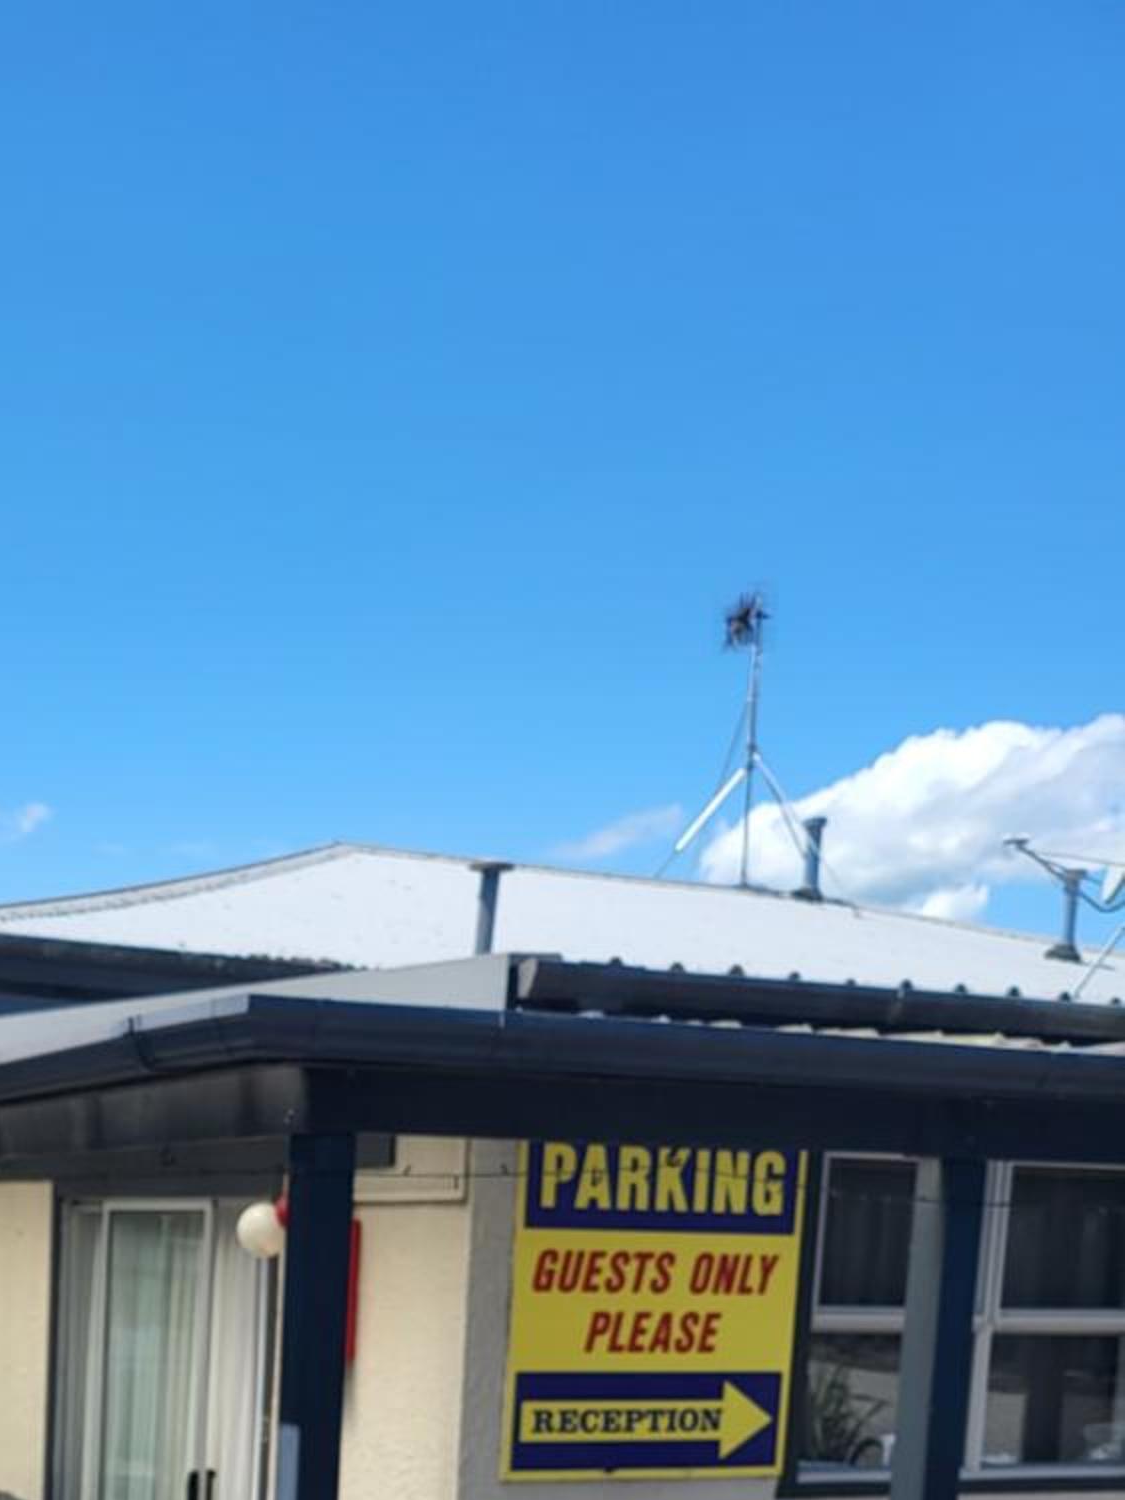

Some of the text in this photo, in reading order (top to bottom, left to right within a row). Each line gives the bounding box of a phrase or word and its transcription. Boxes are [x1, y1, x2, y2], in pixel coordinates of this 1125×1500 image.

[540, 1142, 786, 1216] PARKING
[532, 1249, 779, 1294] GUESTS ONLY
[584, 1311, 722, 1354] PLEASE
[531, 1408, 723, 1434] RECEPTION
